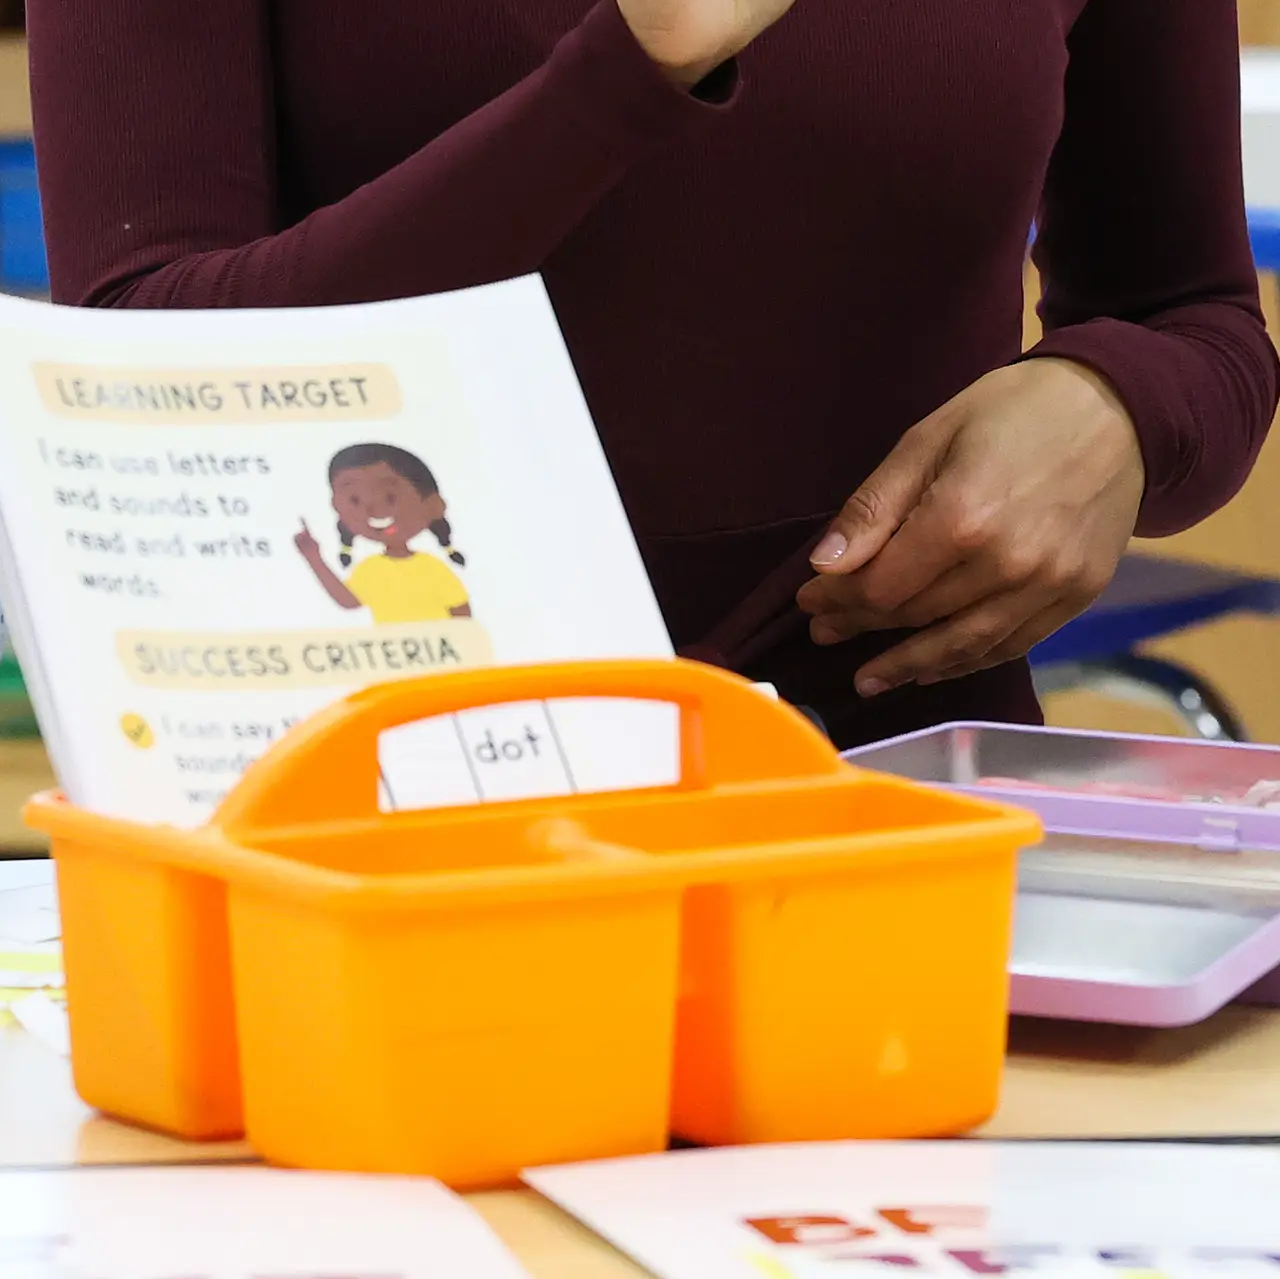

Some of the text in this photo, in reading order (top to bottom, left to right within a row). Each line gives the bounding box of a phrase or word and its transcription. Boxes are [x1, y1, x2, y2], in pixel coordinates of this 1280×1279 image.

[55, 376, 370, 412] LEARNING TARGET
[36, 437, 272, 476] I can use letters
[53, 485, 251, 517] and sounds to
[65, 528, 273, 558] read and write
[133, 635, 463, 678] SUCCESS CRITERIA
[475, 727, 542, 764] dot
